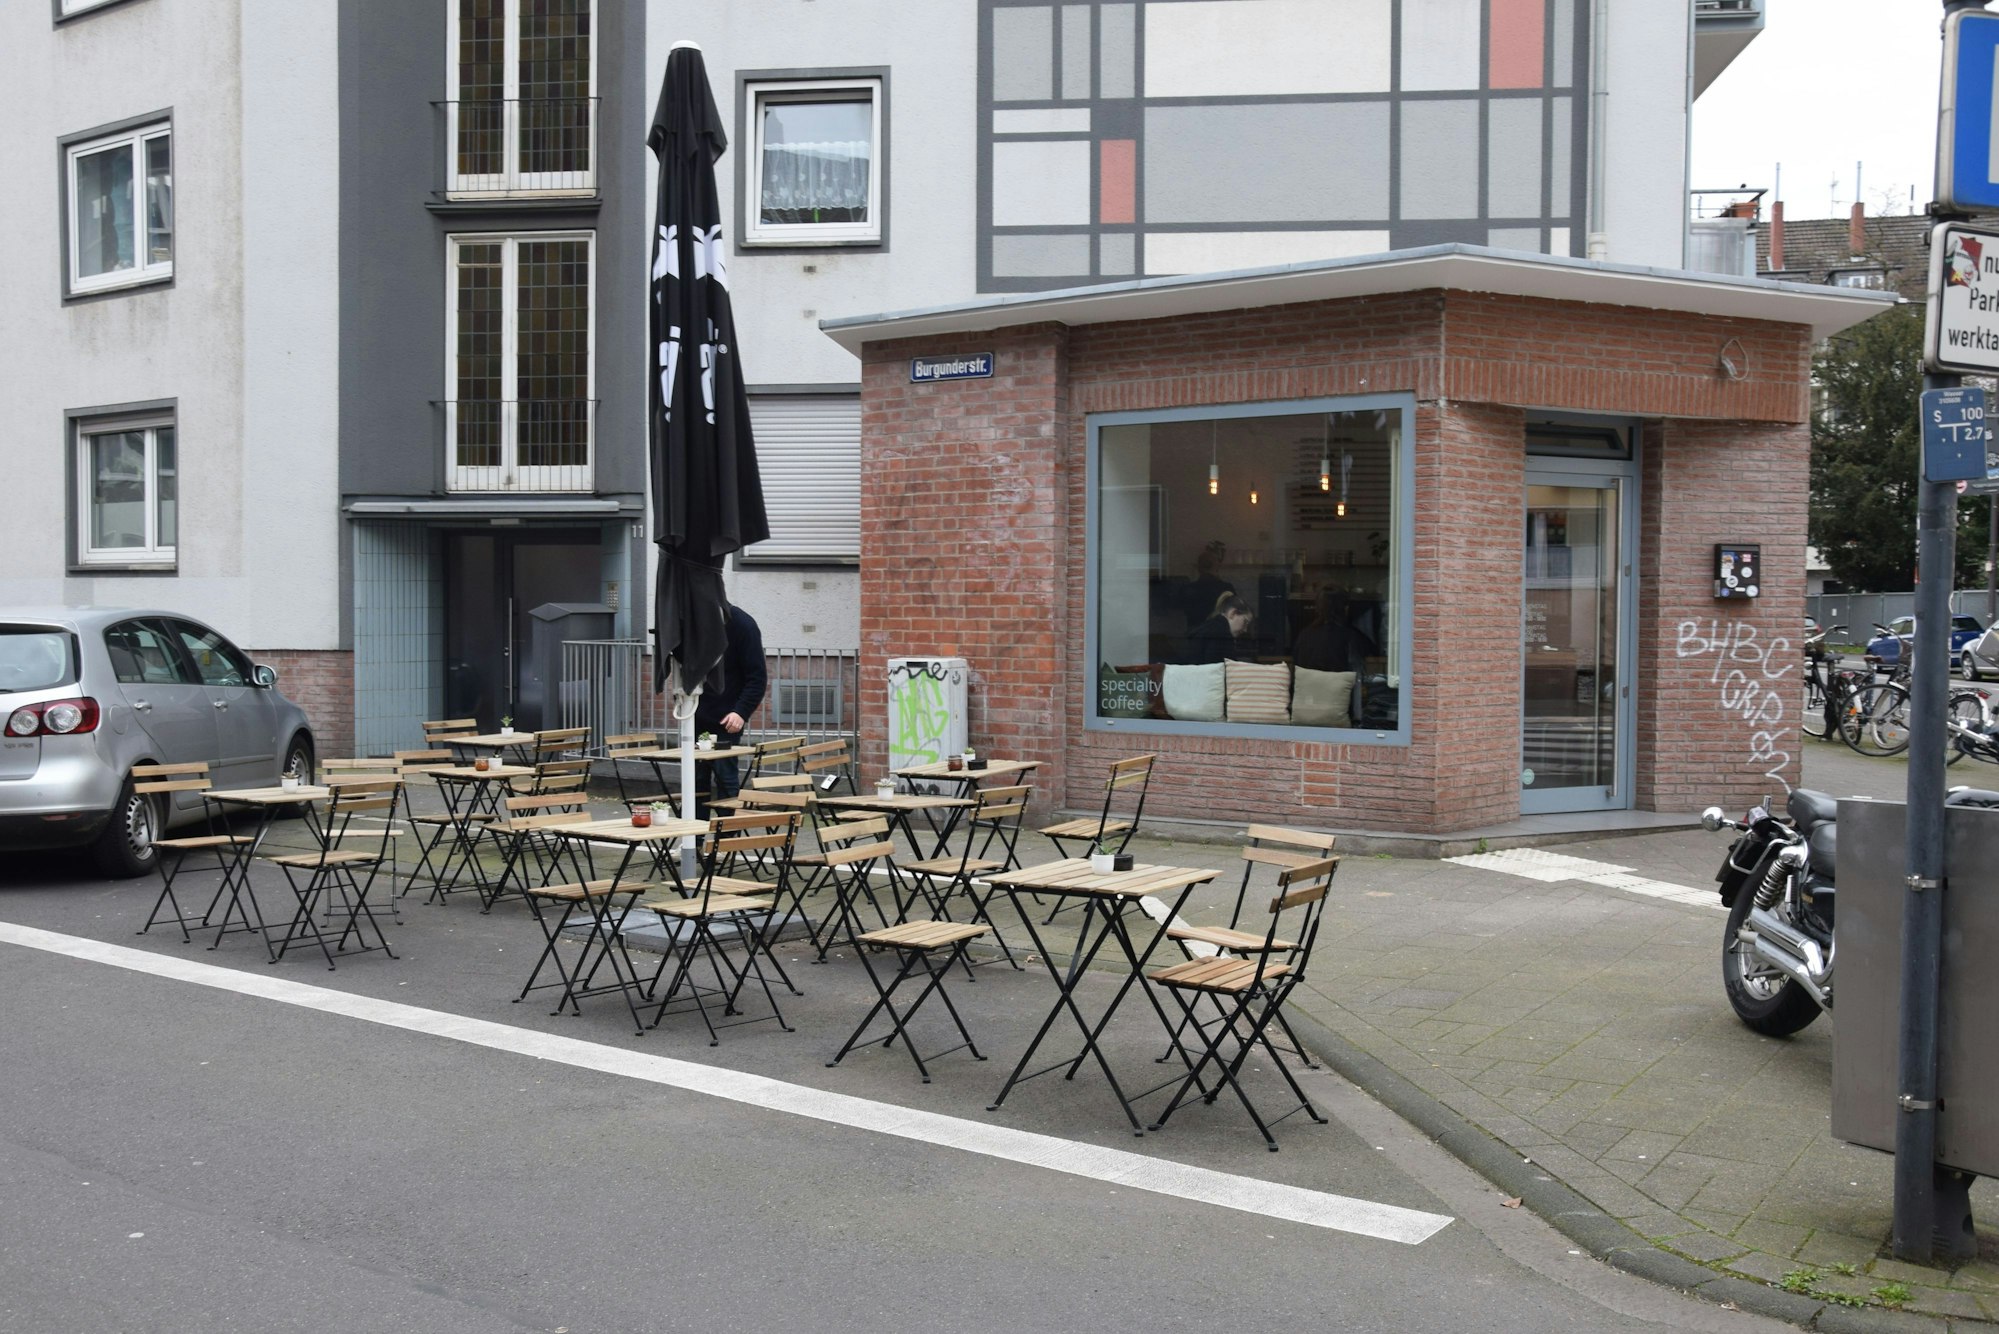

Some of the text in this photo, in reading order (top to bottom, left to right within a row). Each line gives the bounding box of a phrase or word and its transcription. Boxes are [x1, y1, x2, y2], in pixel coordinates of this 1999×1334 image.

[915, 357, 987, 379] Burgunderstr.
[1933, 406, 1984, 423] S 100
[1964, 426, 1984, 441] 2.7
[632, 525, 644, 538] 11
[1101, 677, 1163, 697] specialty
[1101, 695, 1144, 711] coffee
